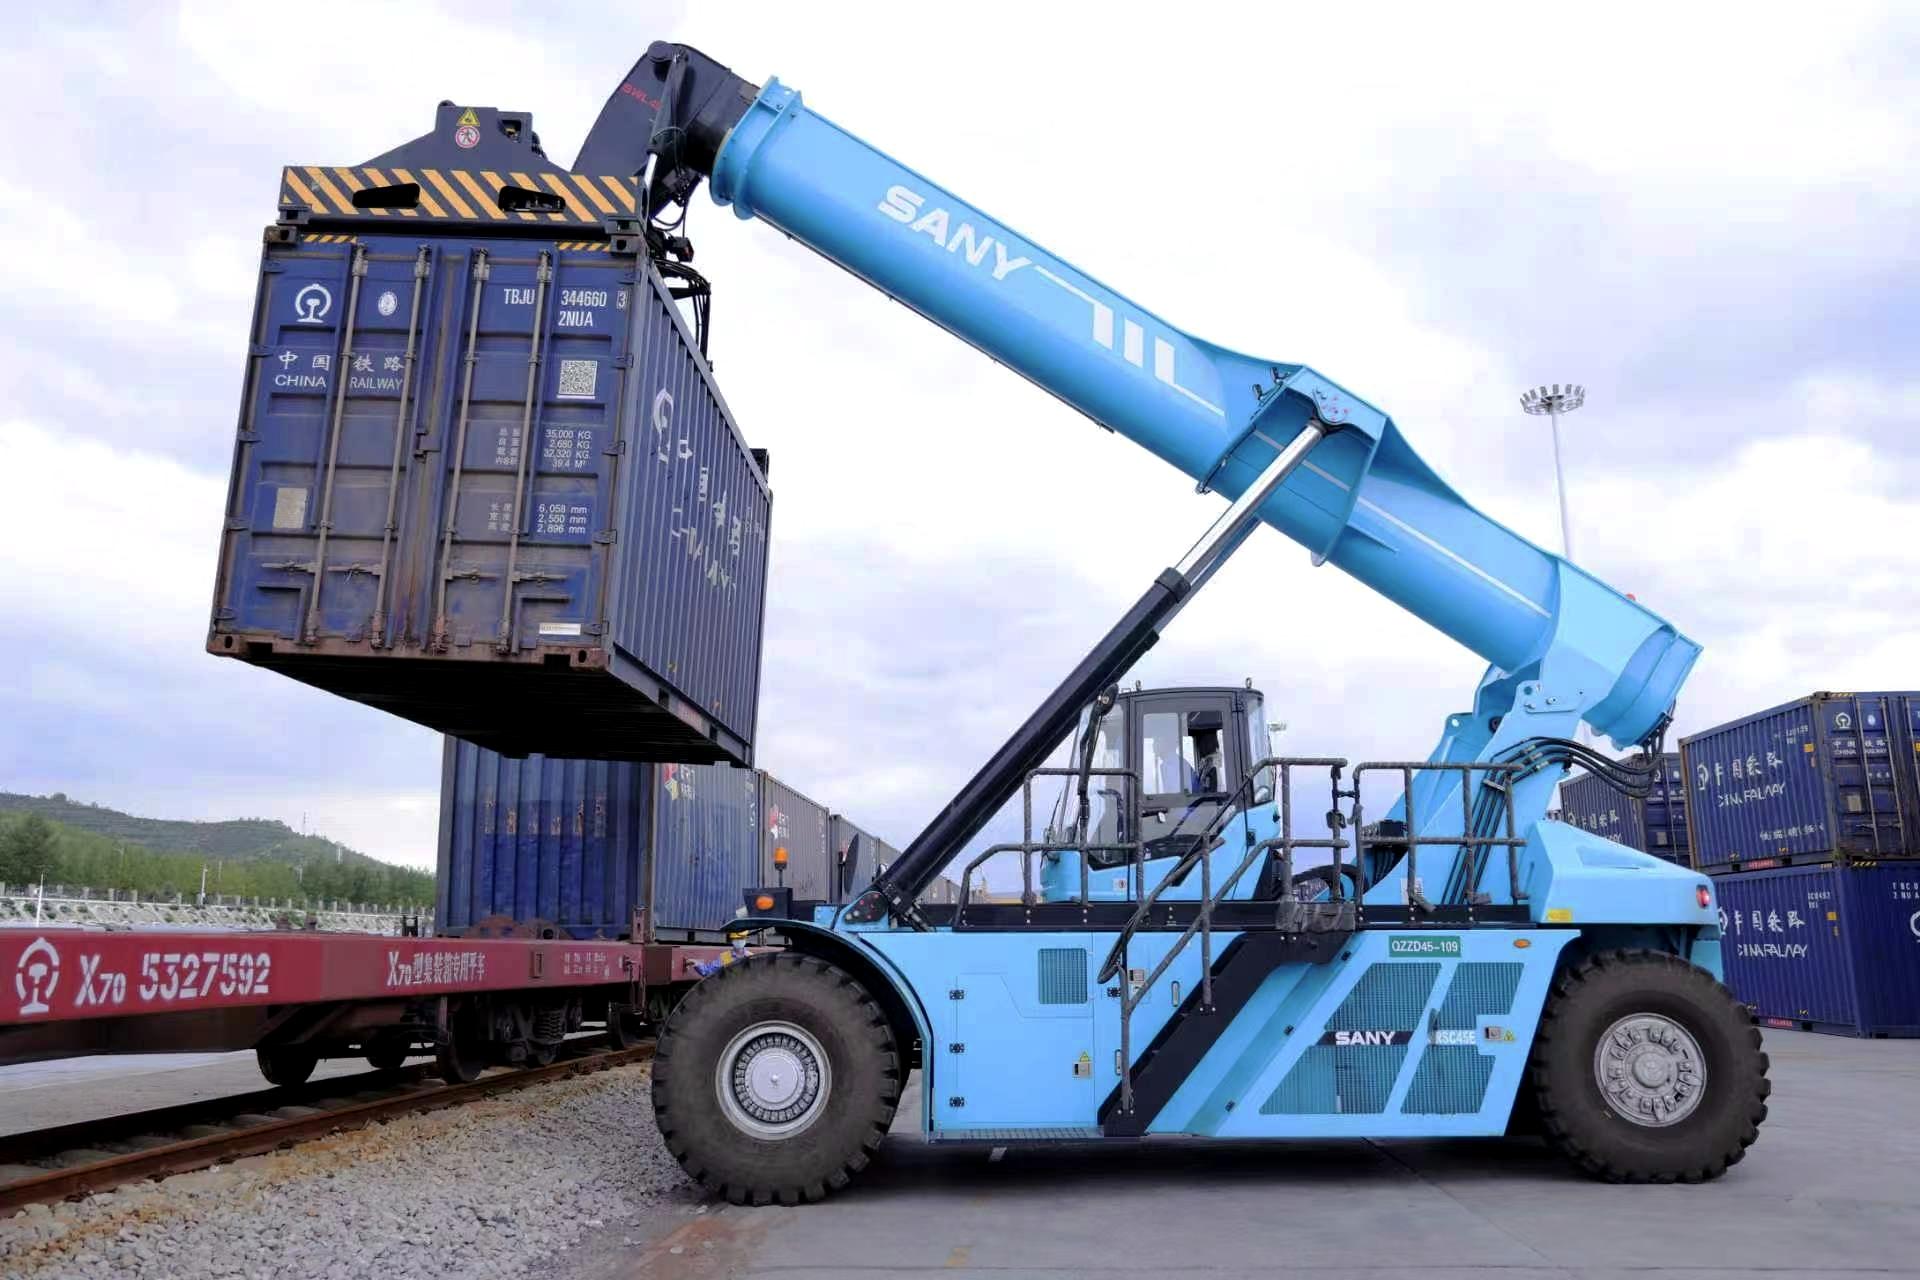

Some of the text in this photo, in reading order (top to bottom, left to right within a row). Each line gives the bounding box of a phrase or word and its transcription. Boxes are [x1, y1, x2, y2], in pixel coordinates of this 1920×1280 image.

[878, 184, 1033, 281] SANY
[503, 288, 536, 305] TBJU
[560, 290, 608, 307] 344660
[558, 311, 593, 327] 2NUA
[274, 374, 403, 390] CHINA RAILWAY
[1391, 939, 1458, 952] QZZD45-109
[139, 952, 271, 1000] 5327592
[1335, 1031, 1396, 1046] SANY
